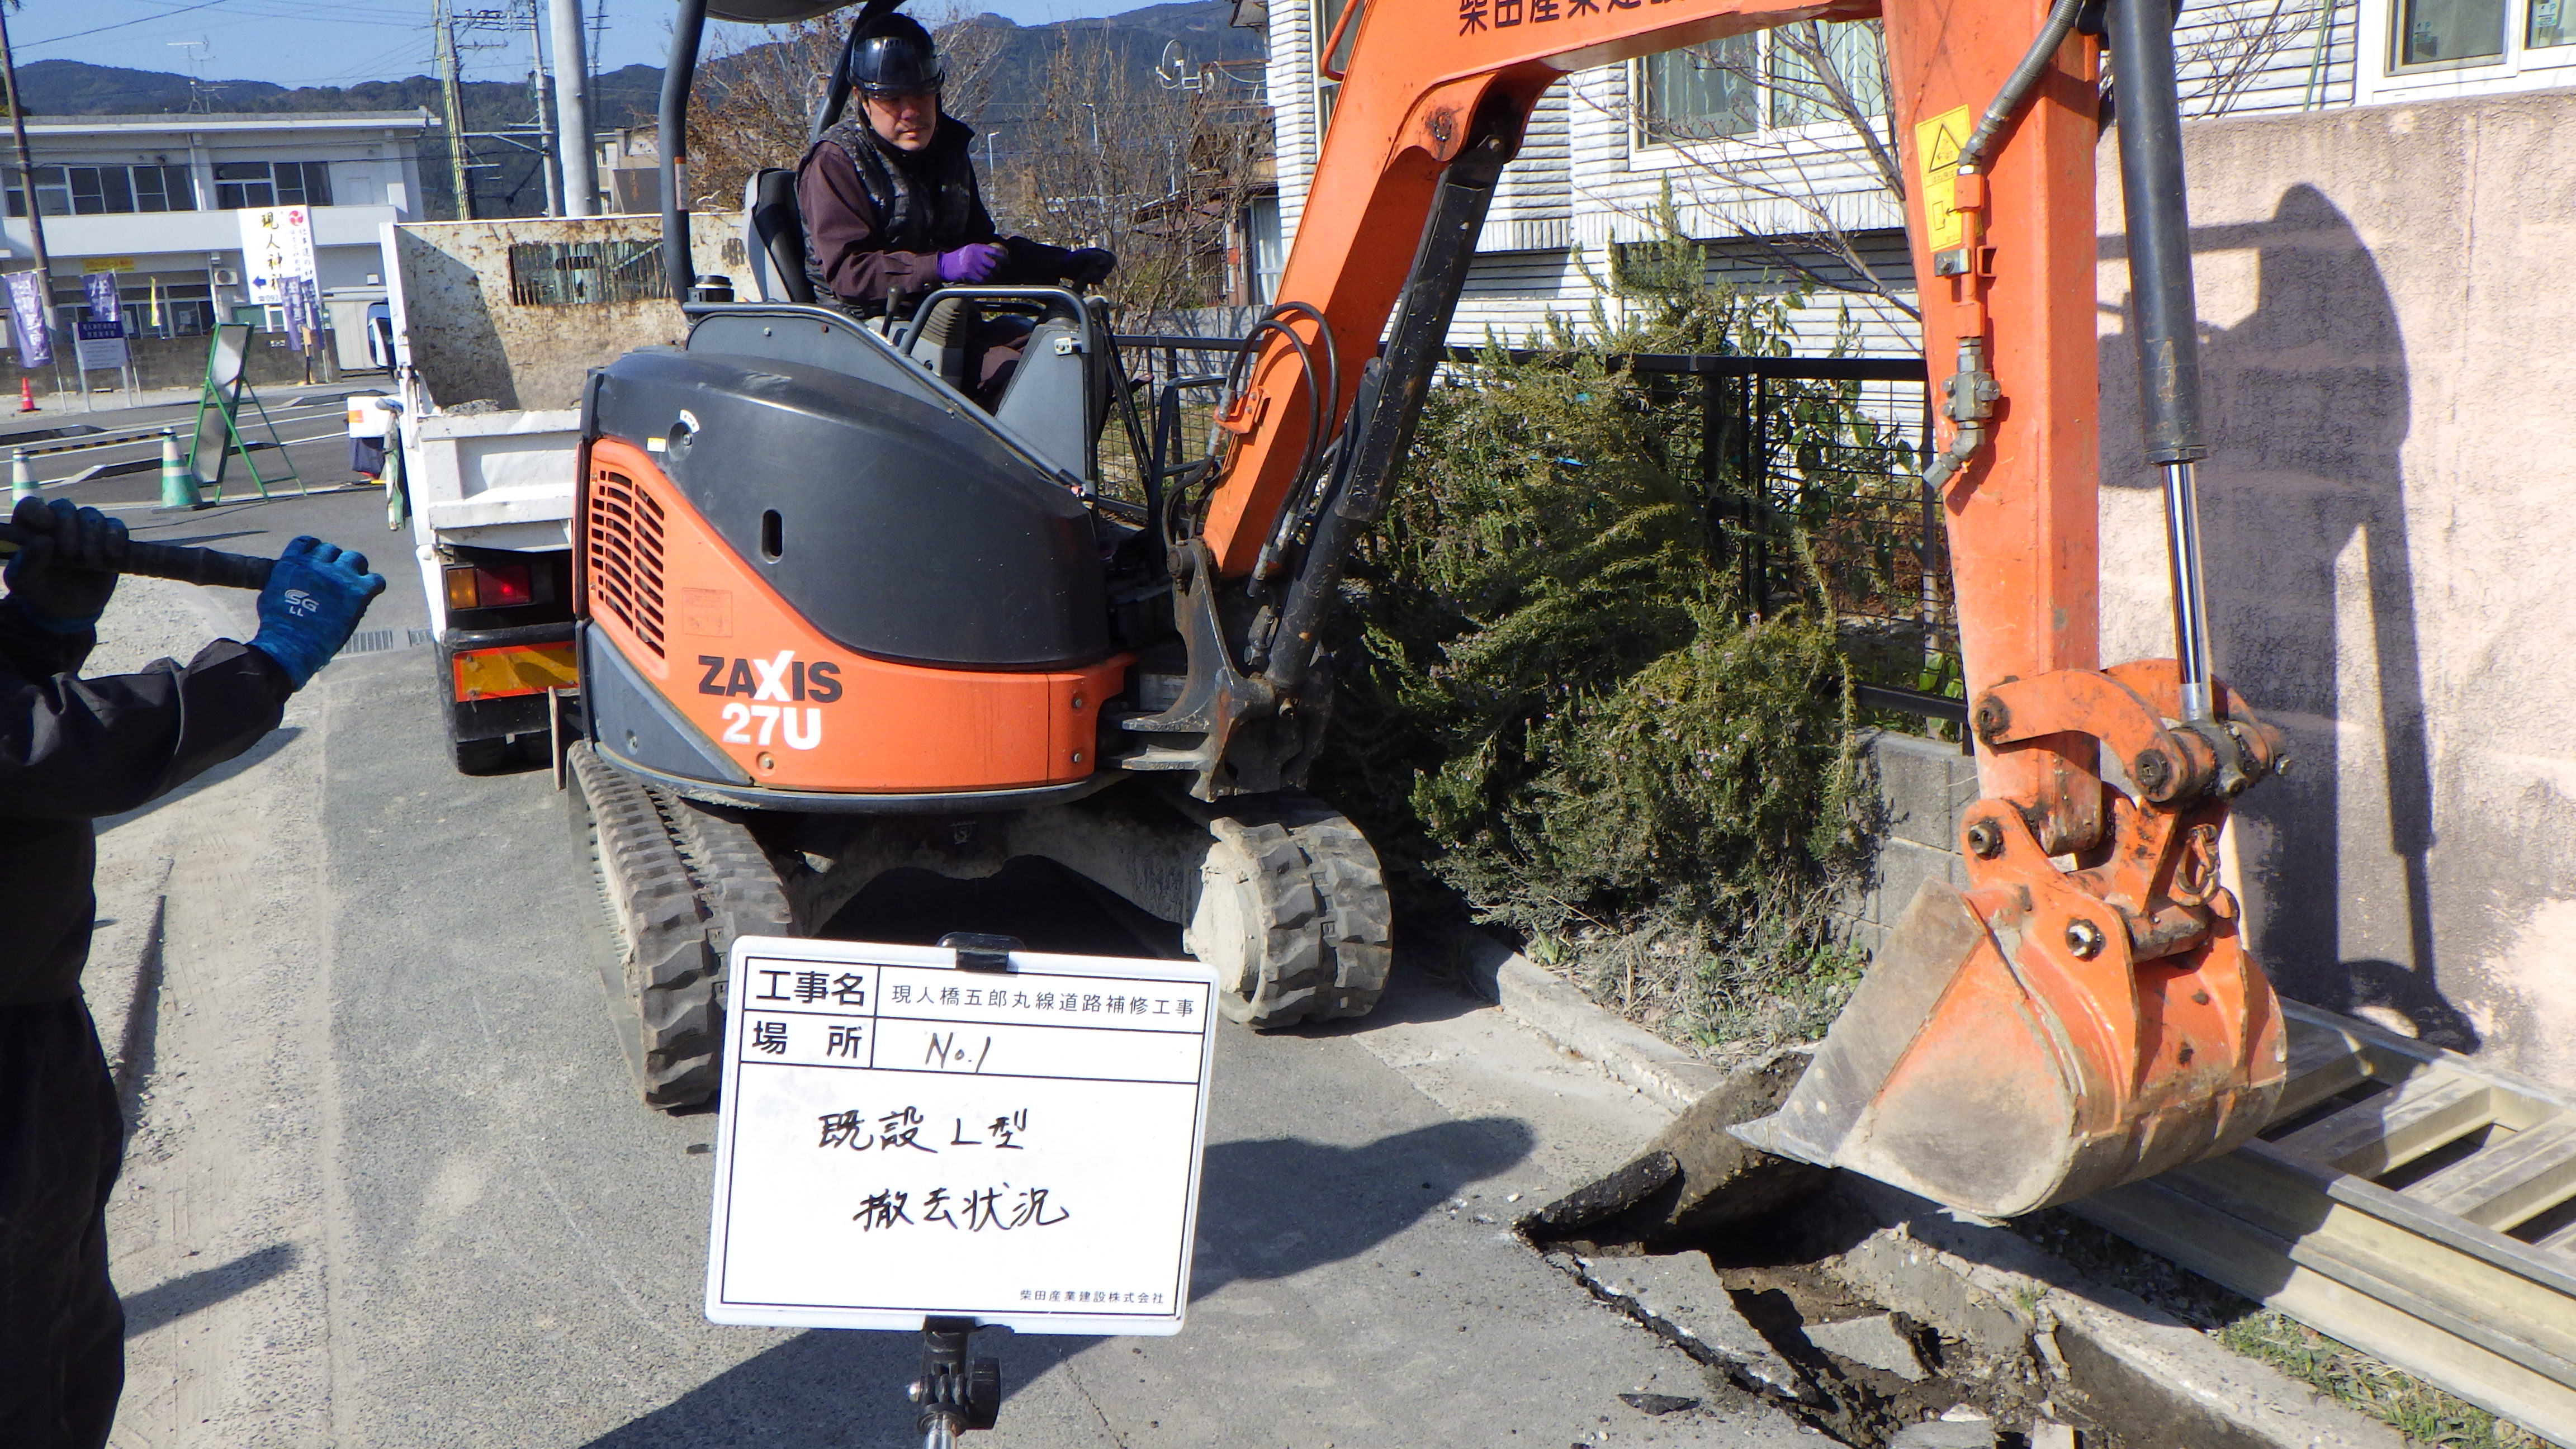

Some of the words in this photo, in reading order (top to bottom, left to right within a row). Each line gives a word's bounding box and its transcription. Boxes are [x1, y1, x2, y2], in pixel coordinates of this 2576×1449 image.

[285, 589, 320, 612] SG
[290, 605, 304, 617] LL
[698, 650, 843, 703] ZAXIS
[721, 703, 822, 750] 27U
[756, 970, 864, 1006] 工事名
[892, 984, 1195, 1016] 現人橋五郎丸線道路補修工事
[924, 1032, 991, 1074] No.1
[853, 1182, 1069, 1232] 撤去状況
[1019, 1290, 1164, 1305] 柴田産業建設株式会社
